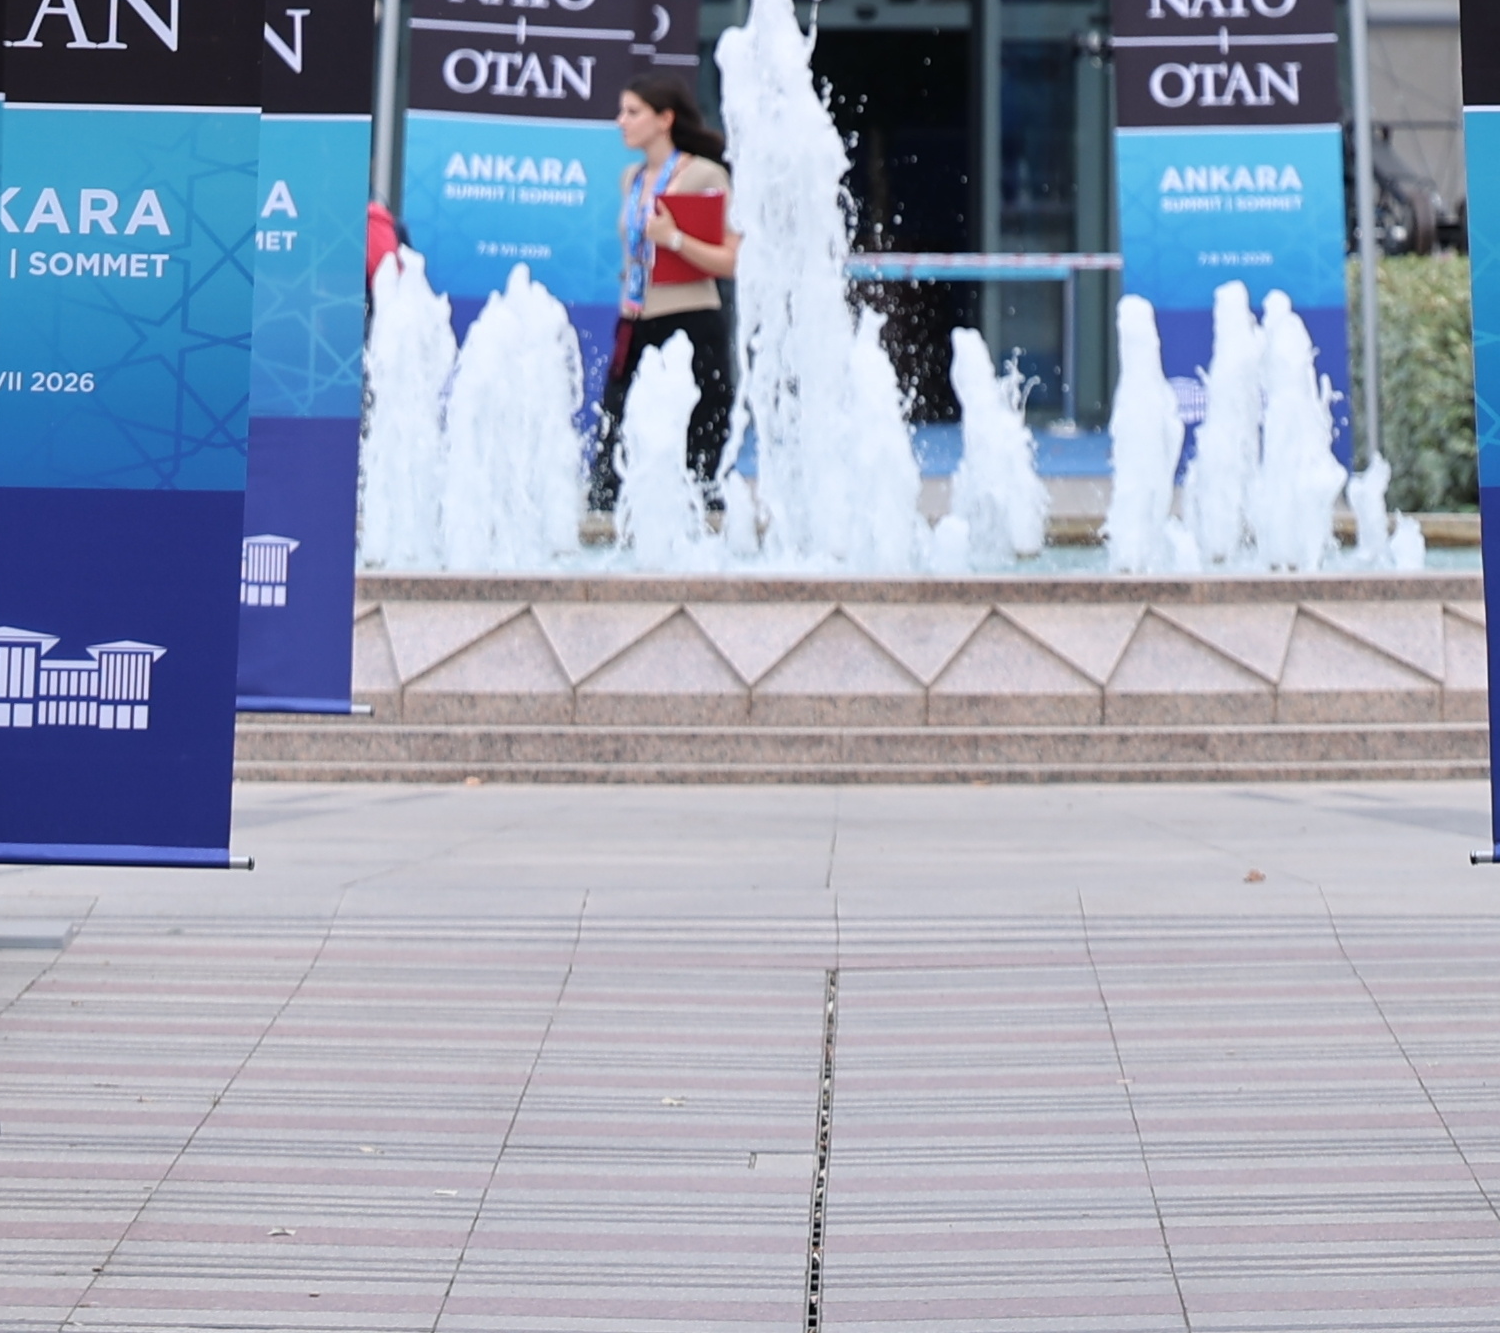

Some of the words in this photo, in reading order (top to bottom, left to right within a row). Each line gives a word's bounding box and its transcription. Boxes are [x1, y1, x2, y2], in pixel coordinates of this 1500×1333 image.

[444, 49, 595, 99] OTAN
[1150, 63, 1299, 107] OTAN
[445, 153, 586, 185] ANKARA
[1161, 165, 1302, 192] ANKARA
[29, 252, 169, 277] SOMMET
[31, 372, 94, 392] 2026
